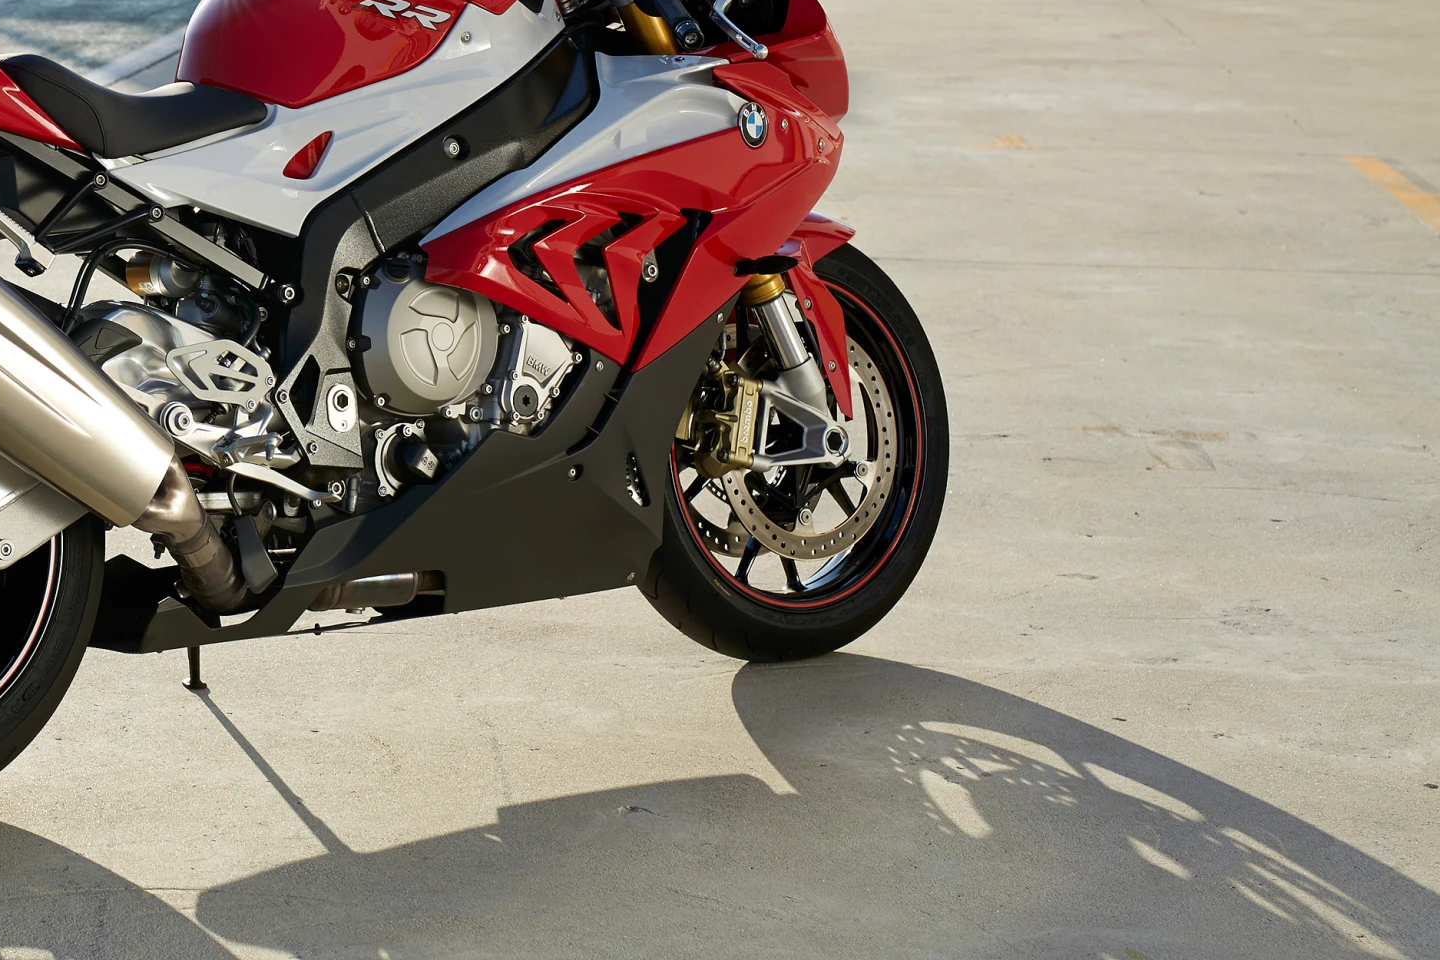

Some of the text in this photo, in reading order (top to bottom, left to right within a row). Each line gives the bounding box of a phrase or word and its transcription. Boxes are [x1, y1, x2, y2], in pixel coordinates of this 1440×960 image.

[743, 103, 765, 119] BMW
[526, 355, 551, 376] BMW
[741, 400, 753, 444] brembo
